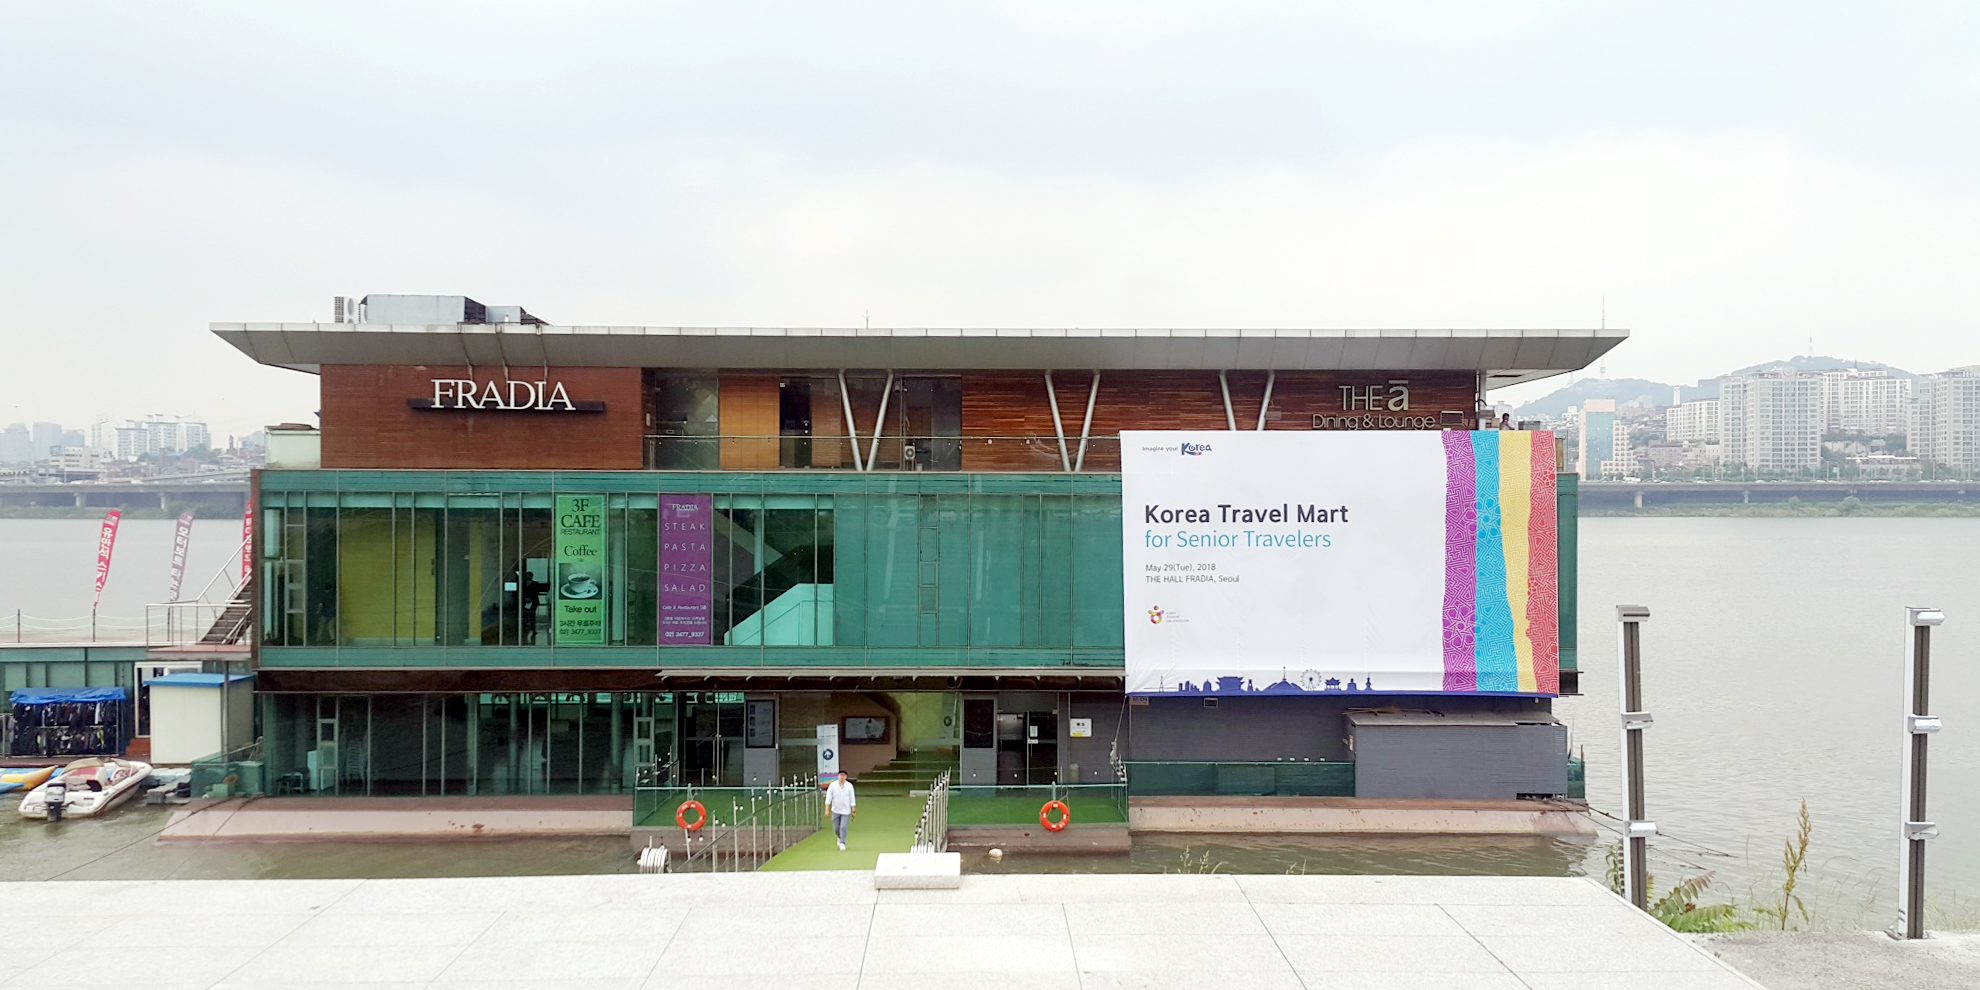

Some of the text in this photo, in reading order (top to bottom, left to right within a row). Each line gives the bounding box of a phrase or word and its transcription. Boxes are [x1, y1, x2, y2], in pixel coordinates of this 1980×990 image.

[430, 378, 577, 411] FRADIA
[1338, 385, 1384, 411] THE
[1312, 413, 1436, 430] Dining & Lounge
[1181, 442, 1213, 456] Korea
[571, 498, 590, 513] 3F
[1145, 503, 1349, 523] Korea Travel Mart
[560, 514, 601, 528] CAFE
[664, 522, 705, 531] STEAK
[1144, 529, 1331, 548] for Senior Travelers
[563, 544, 598, 557] Coffee
[664, 543, 706, 551] PASTA
[664, 563, 706, 572] PIZZA
[1145, 563, 1217, 573] May 29(Tue), 2018
[1145, 574, 1240, 584] THE HALL FRADIA, Seoul
[664, 584, 706, 592] SALAD
[563, 605, 597, 613] Take out
